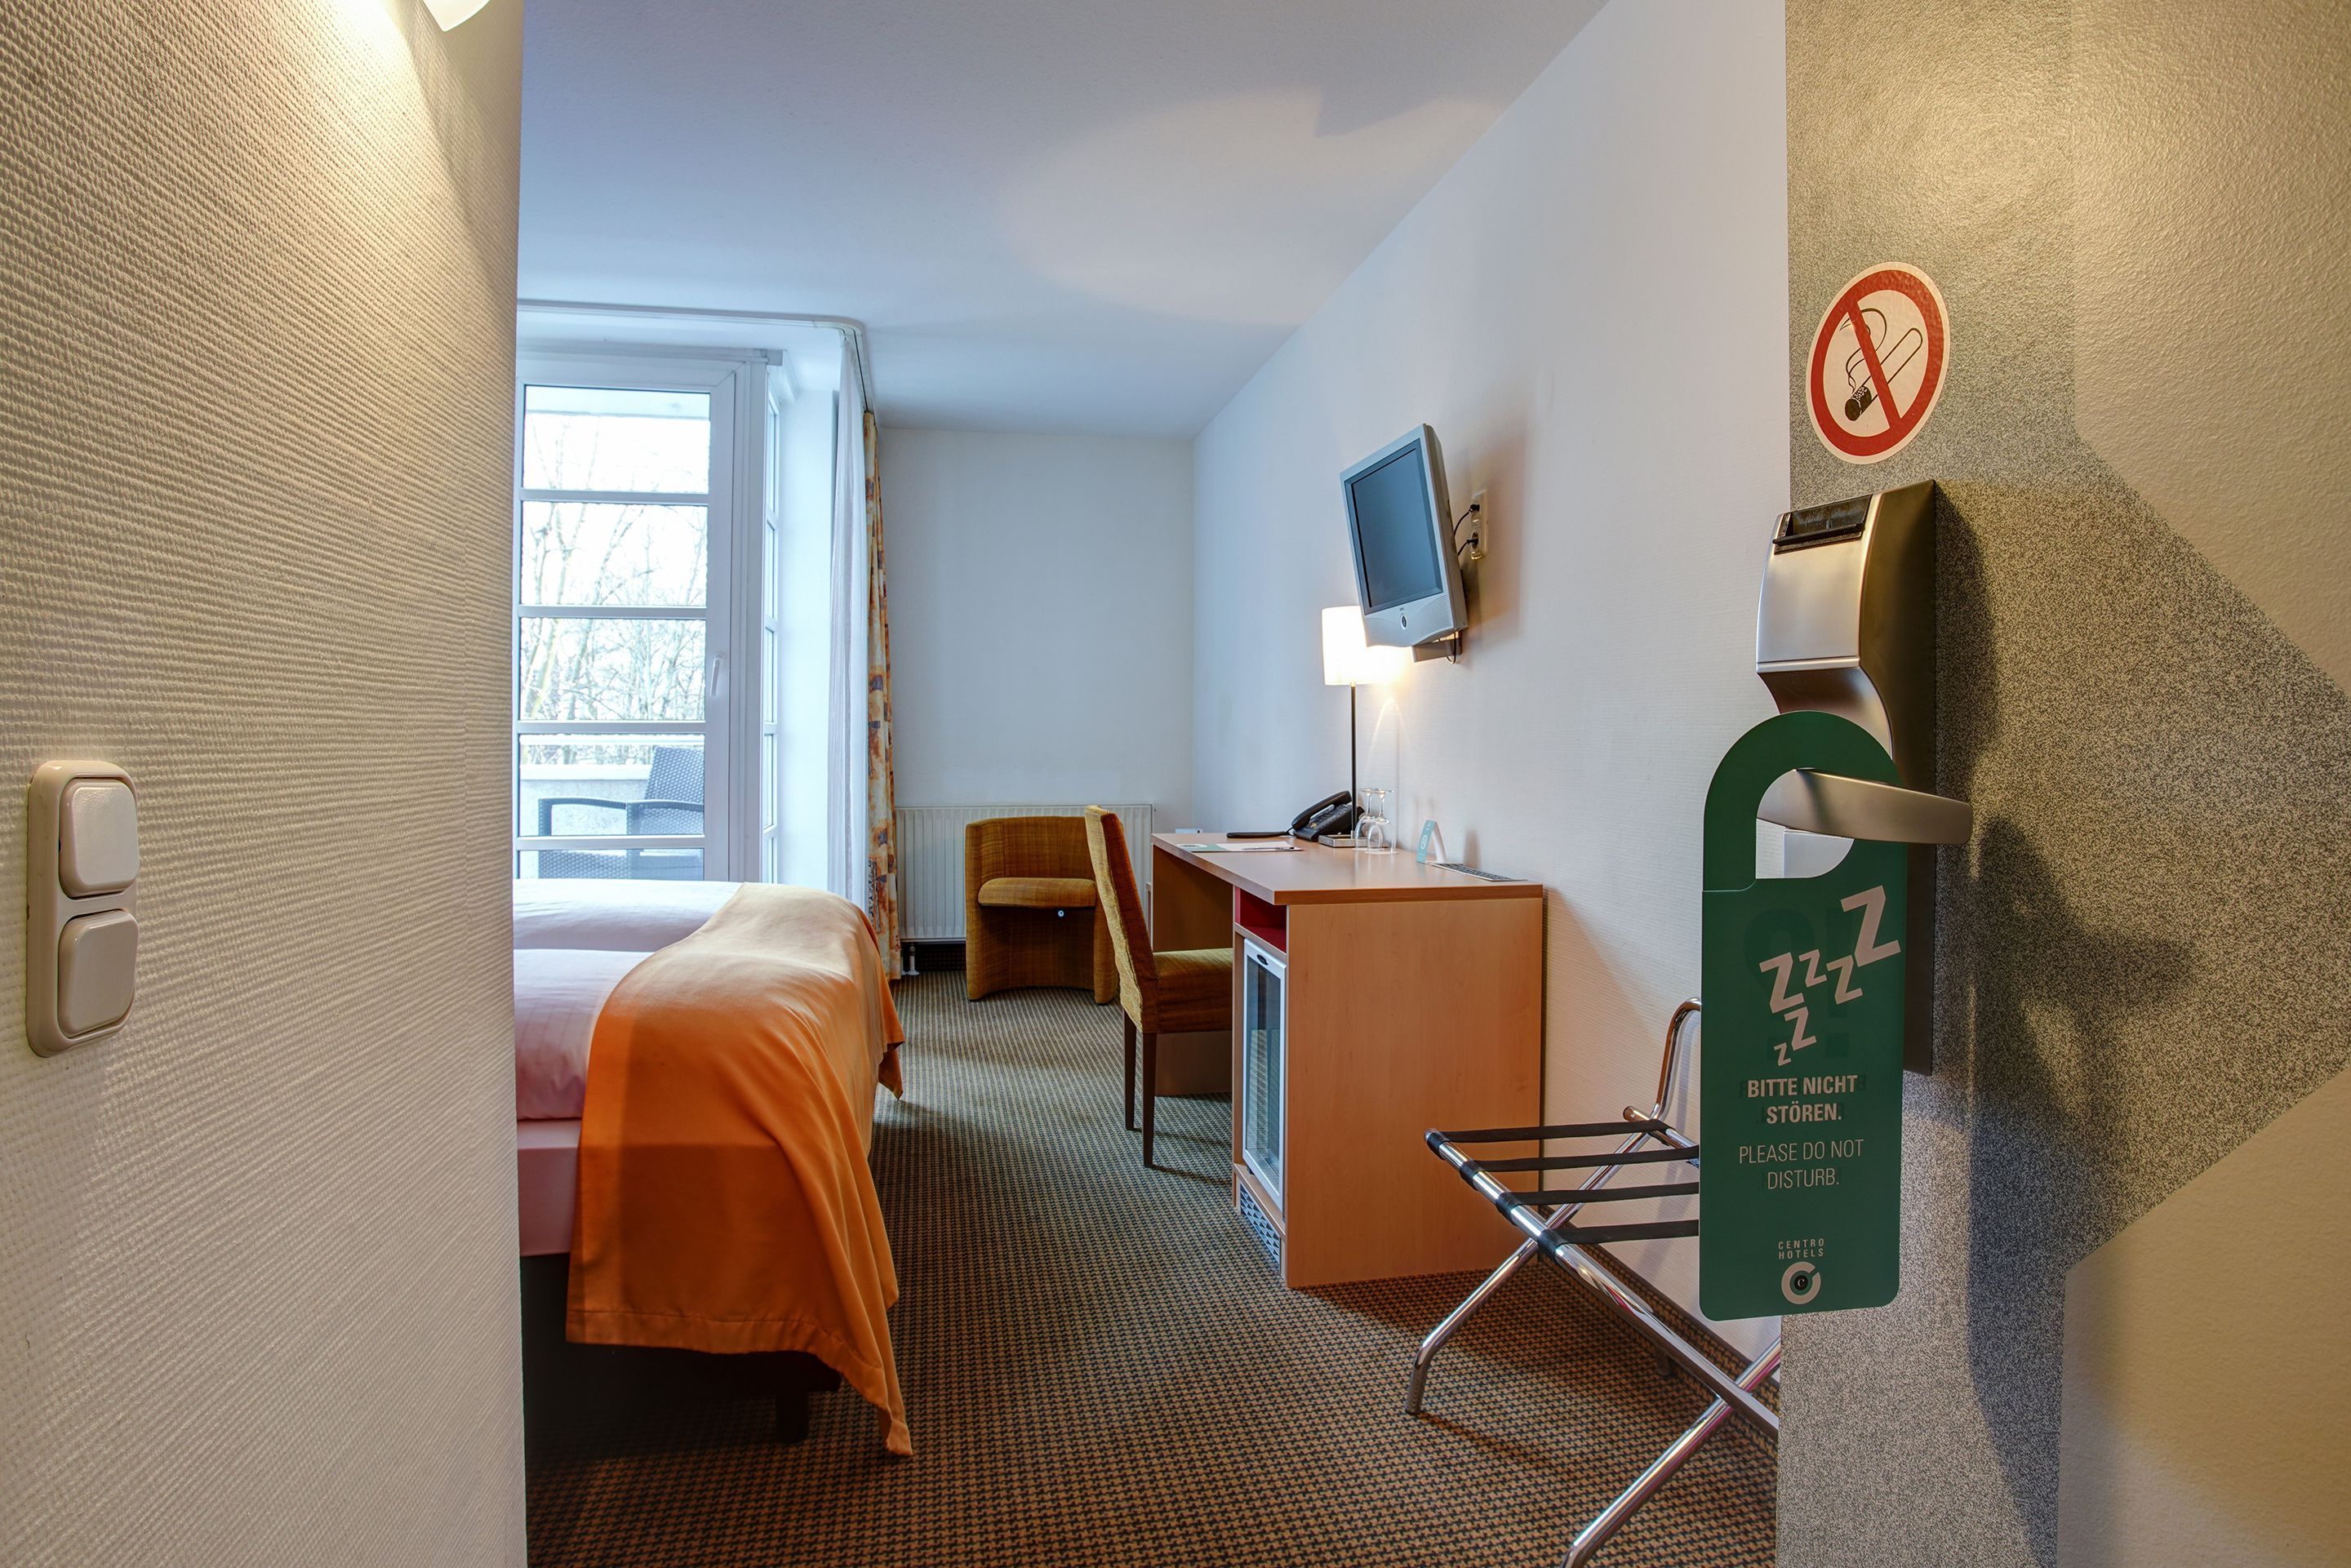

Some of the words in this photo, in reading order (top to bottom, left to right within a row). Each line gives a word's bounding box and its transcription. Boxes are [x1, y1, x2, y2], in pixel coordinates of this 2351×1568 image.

[1747, 1077, 1798, 1098] BITTE
[1802, 1074, 1858, 1095] NICHT
[1766, 1102, 1842, 1125] STÖREN.
[1739, 1142, 1798, 1164] PLEASE
[1802, 1141, 1825, 1160] DO
[1830, 1139, 1864, 1158] NOT
[1767, 1167, 1840, 1190] DISTURB.
[1778, 1237, 1825, 1250] CENTRO
[1778, 1247, 1824, 1260] HOTELS
